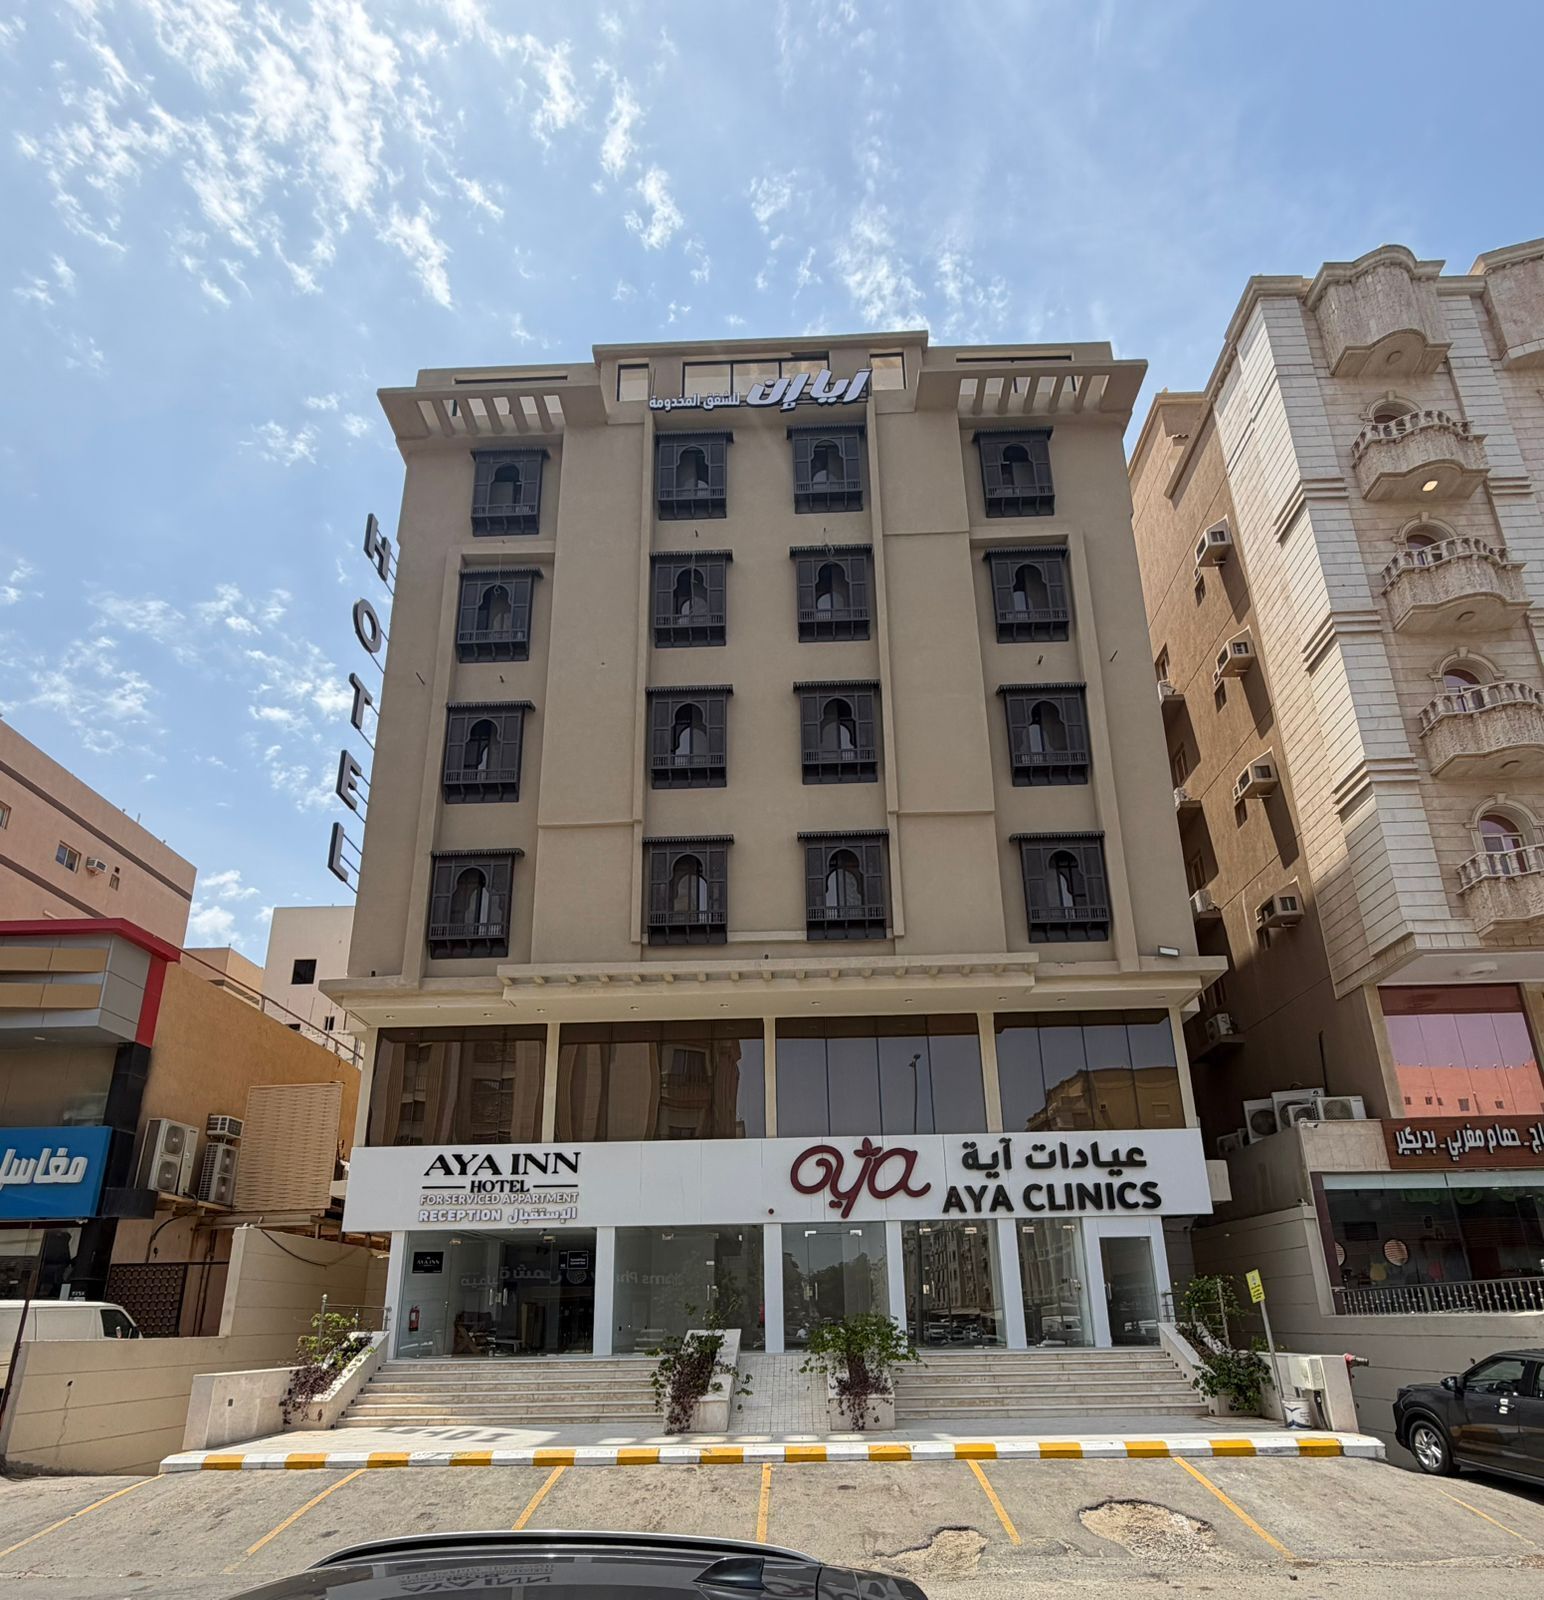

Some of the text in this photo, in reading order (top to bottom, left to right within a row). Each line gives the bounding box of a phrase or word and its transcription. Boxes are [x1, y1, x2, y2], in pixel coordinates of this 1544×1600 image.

[746, 372, 811, 412] إن
[809, 367, 872, 406] آيا
[649, 392, 701, 413] المخدومة
[327, 512, 391, 883] HOTEL
[1395, 1126, 1437, 1155] بديكير
[1446, 1123, 1485, 1161] مغربي
[1486, 1123, 1522, 1154] حمام
[423, 1152, 581, 1176] AYA INN
[961, 1137, 1147, 1179] عيادات آية
[420, 1191, 579, 1206] FOR SERVICED APPARTMENT
[470, 1179, 530, 1193] HOTEL
[942, 1181, 1162, 1213] AYA CLINICS
[418, 1208, 502, 1222] RECEPTION
